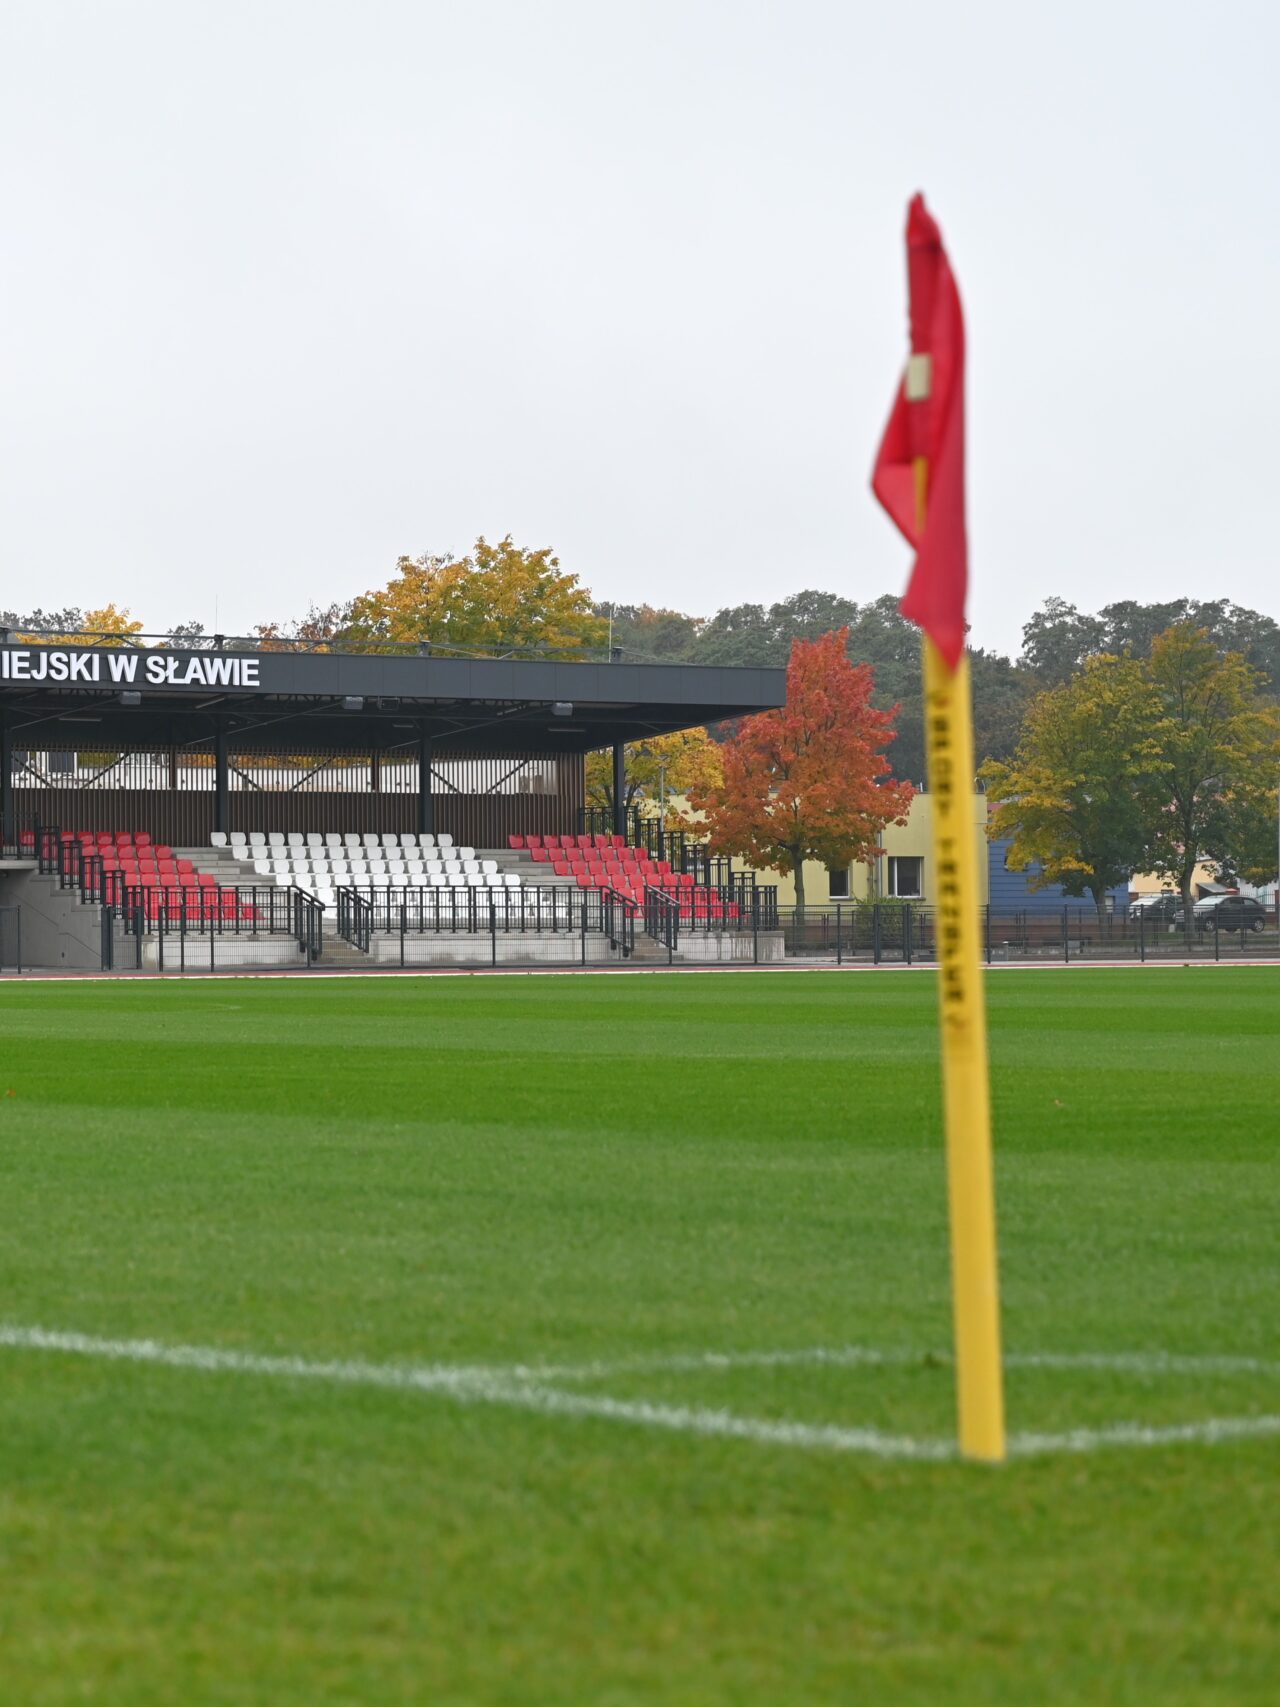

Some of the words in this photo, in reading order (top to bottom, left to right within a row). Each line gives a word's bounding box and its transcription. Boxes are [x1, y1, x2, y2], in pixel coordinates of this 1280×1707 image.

[107, 654, 138, 682] W
[145, 656, 260, 686] SŁAWIE
[931, 716, 953, 818] SPORT
